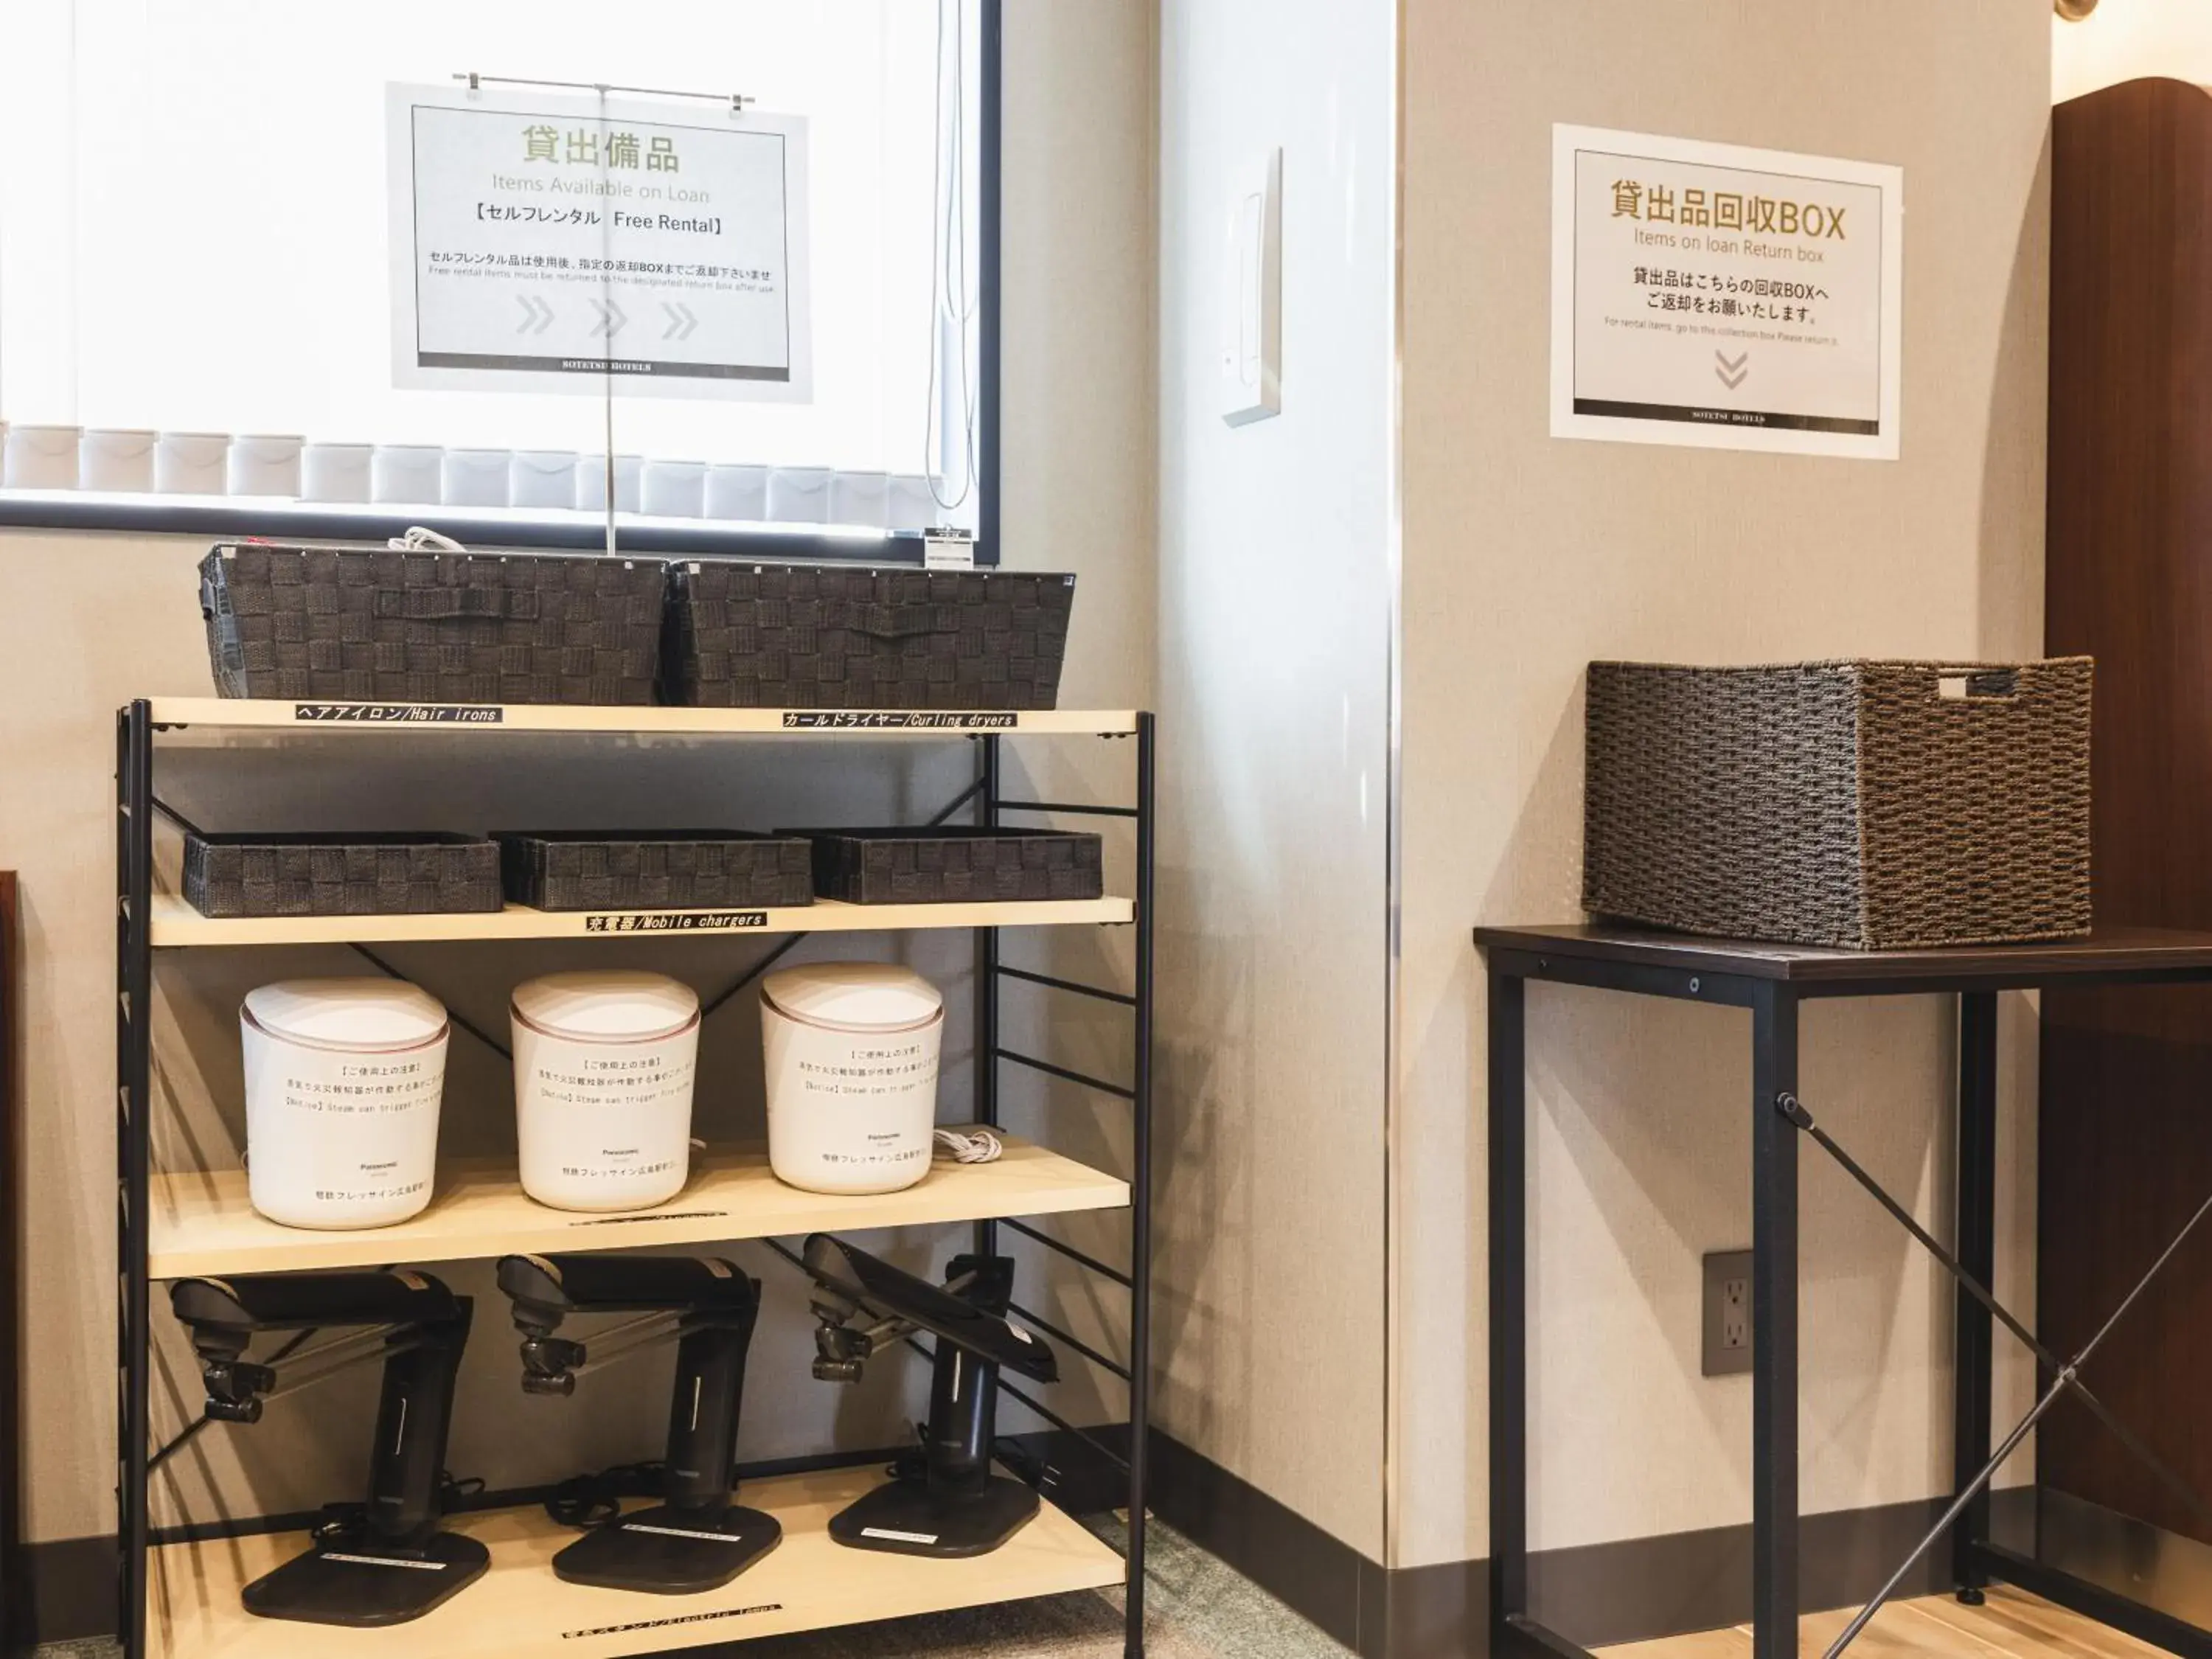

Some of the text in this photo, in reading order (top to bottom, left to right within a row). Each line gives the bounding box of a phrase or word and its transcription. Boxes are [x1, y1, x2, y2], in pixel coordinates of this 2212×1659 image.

[522, 125, 679, 173] 貸出備品
[493, 174, 710, 204] Items Available on Loan
[615, 212, 653, 229] Free
[1611, 179, 1846, 240] 貸出品回収BOX
[1635, 227, 1824, 263] Items on loan Return box
[1634, 266, 1829, 301] 貸出品はこちらの回収BOXへ
[297, 705, 497, 722] ヘアアイロン/Hair irons
[785, 712, 1013, 728] カールドライヤー/Curling dryers
[698, 914, 762, 929] chargers
